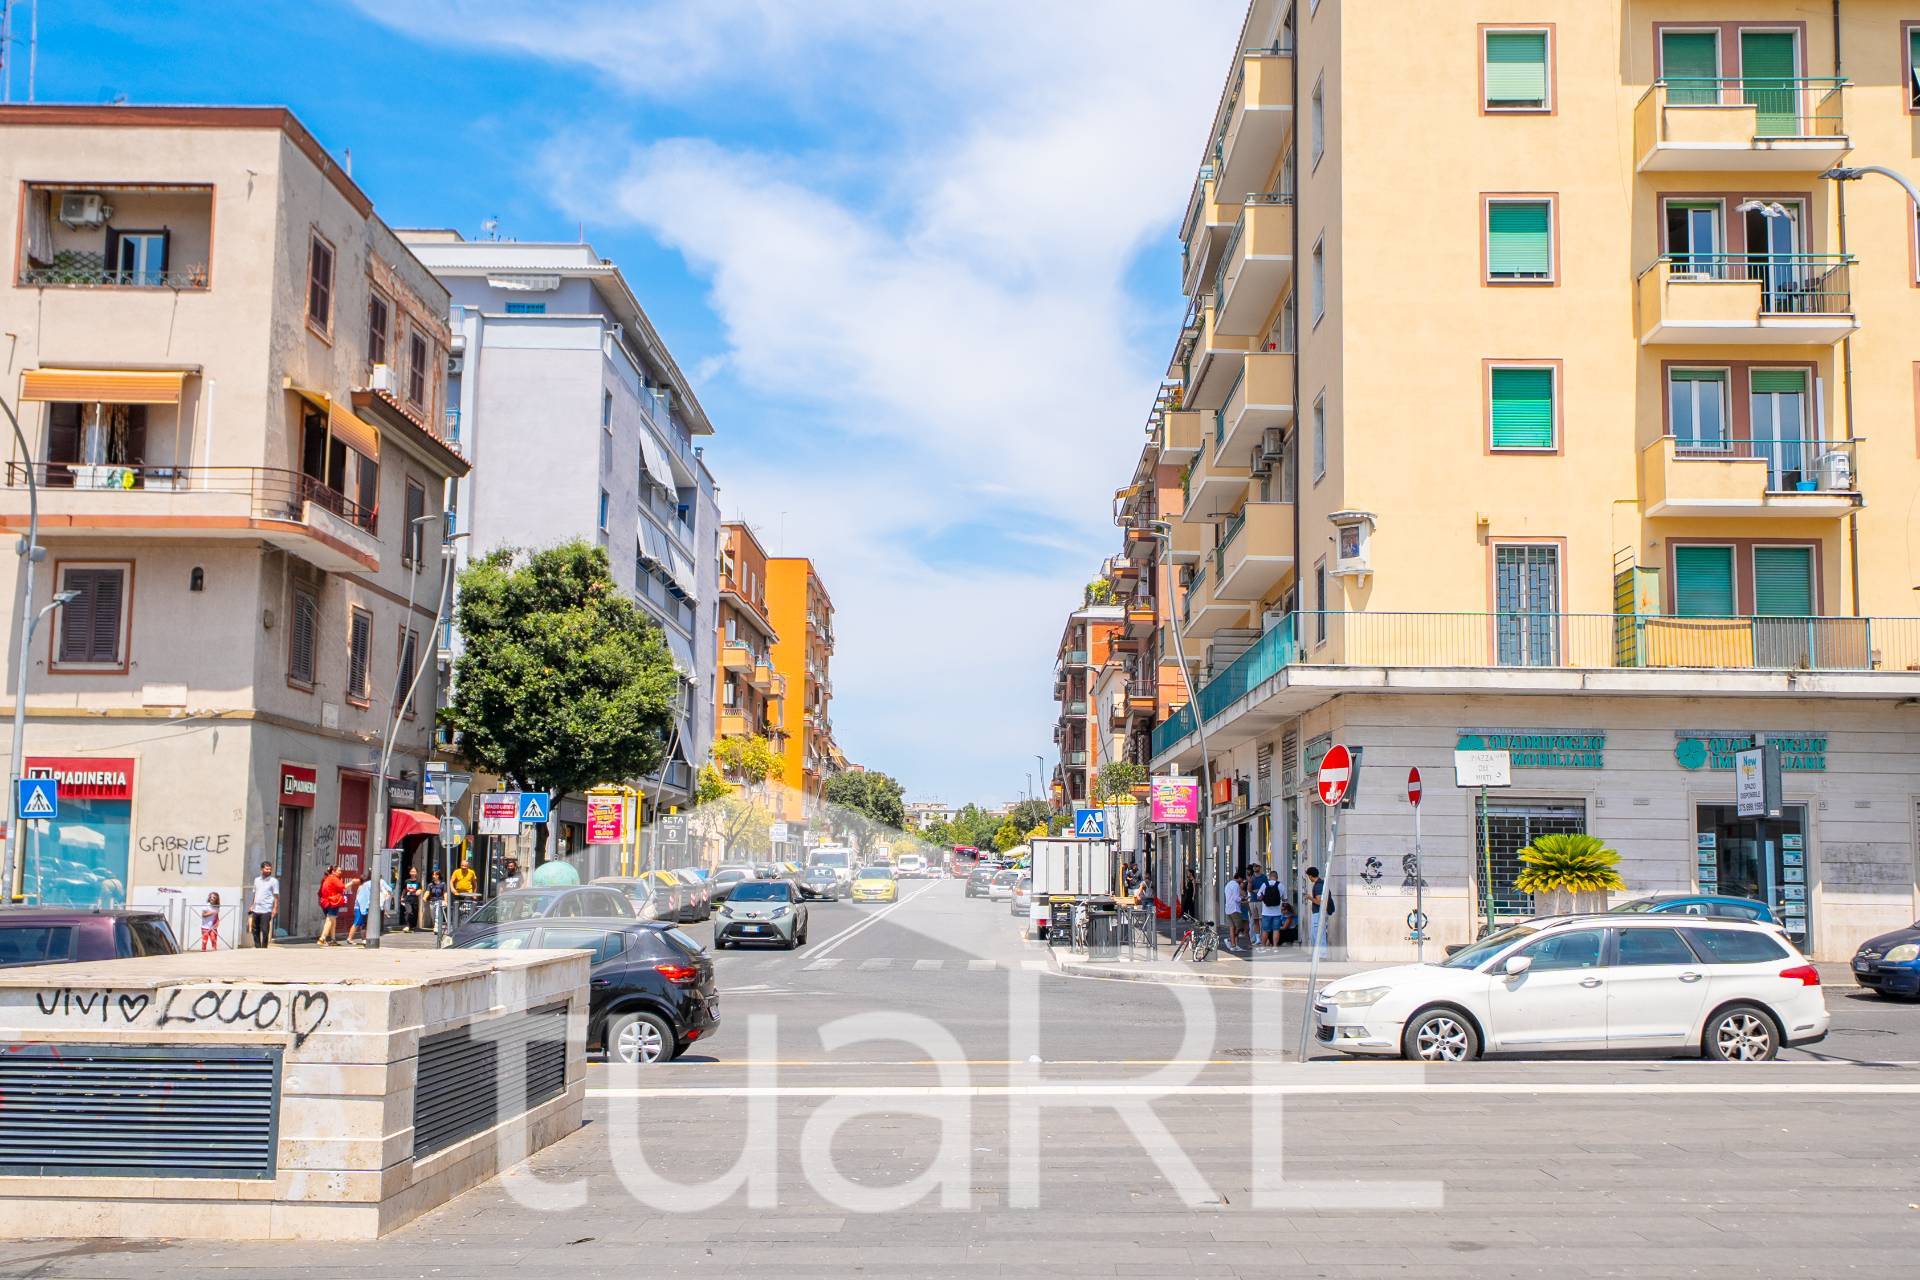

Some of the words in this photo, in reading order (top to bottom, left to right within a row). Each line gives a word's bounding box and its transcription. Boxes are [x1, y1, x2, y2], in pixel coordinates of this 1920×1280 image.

[1489, 735, 1605, 750] QUADRIFOGLIO
[1511, 752, 1604, 767] MOBILIARE
[54, 771, 126, 785] PIADINERIA
[139, 834, 231, 854] GABRIELE
[158, 852, 202, 875] VIVE
